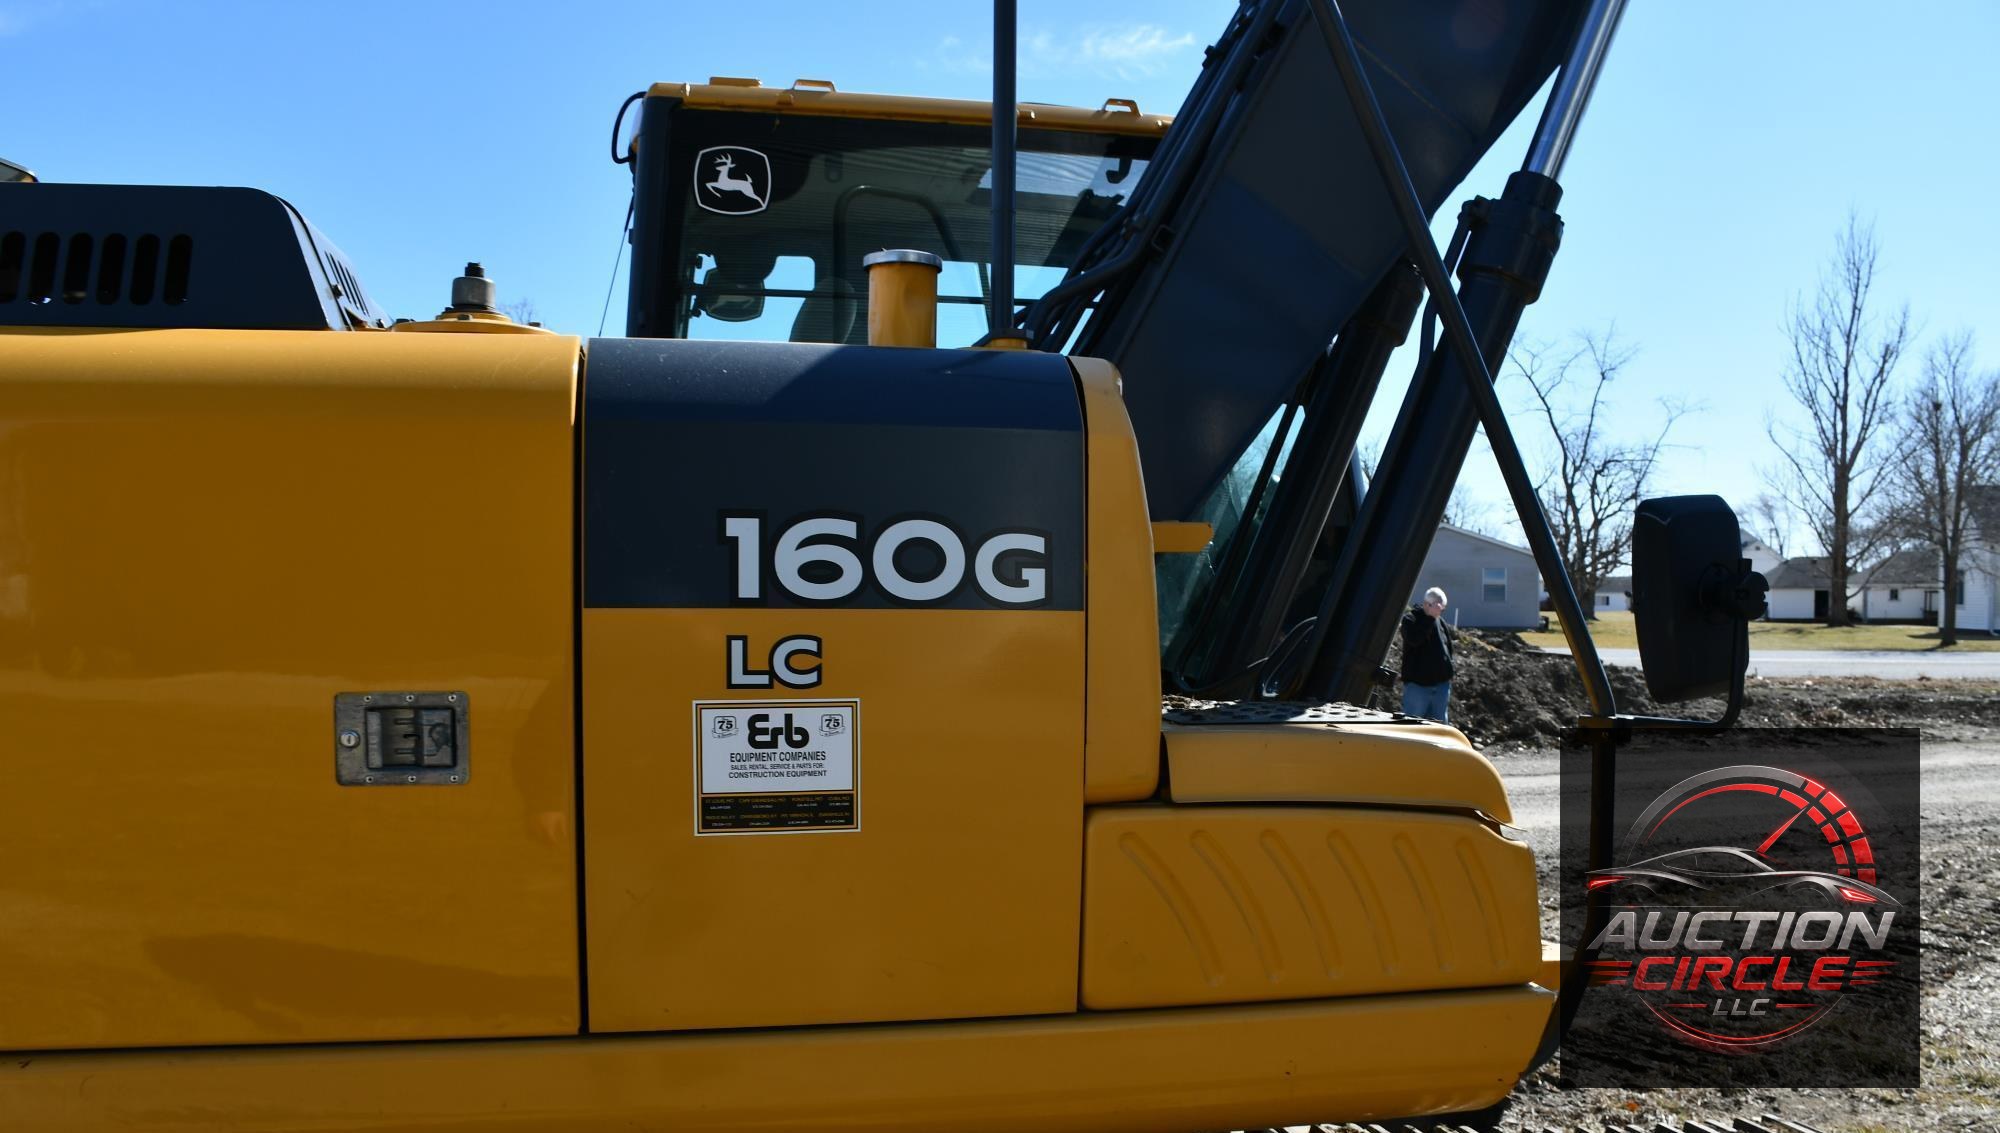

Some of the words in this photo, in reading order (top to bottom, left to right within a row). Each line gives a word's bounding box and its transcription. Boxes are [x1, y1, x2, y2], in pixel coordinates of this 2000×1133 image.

[722, 515, 1049, 605] 160G
[727, 635, 823, 690] LC
[717, 720, 733, 730] 75
[824, 718, 840, 728] 75
[747, 713, 810, 749] Erb
[729, 752, 777, 763] EQUIPMENT
[779, 751, 826, 762] COMPANIES
[728, 770, 785, 779] CONSTRUCTION
[786, 770, 827, 778] EQUIPMENT
